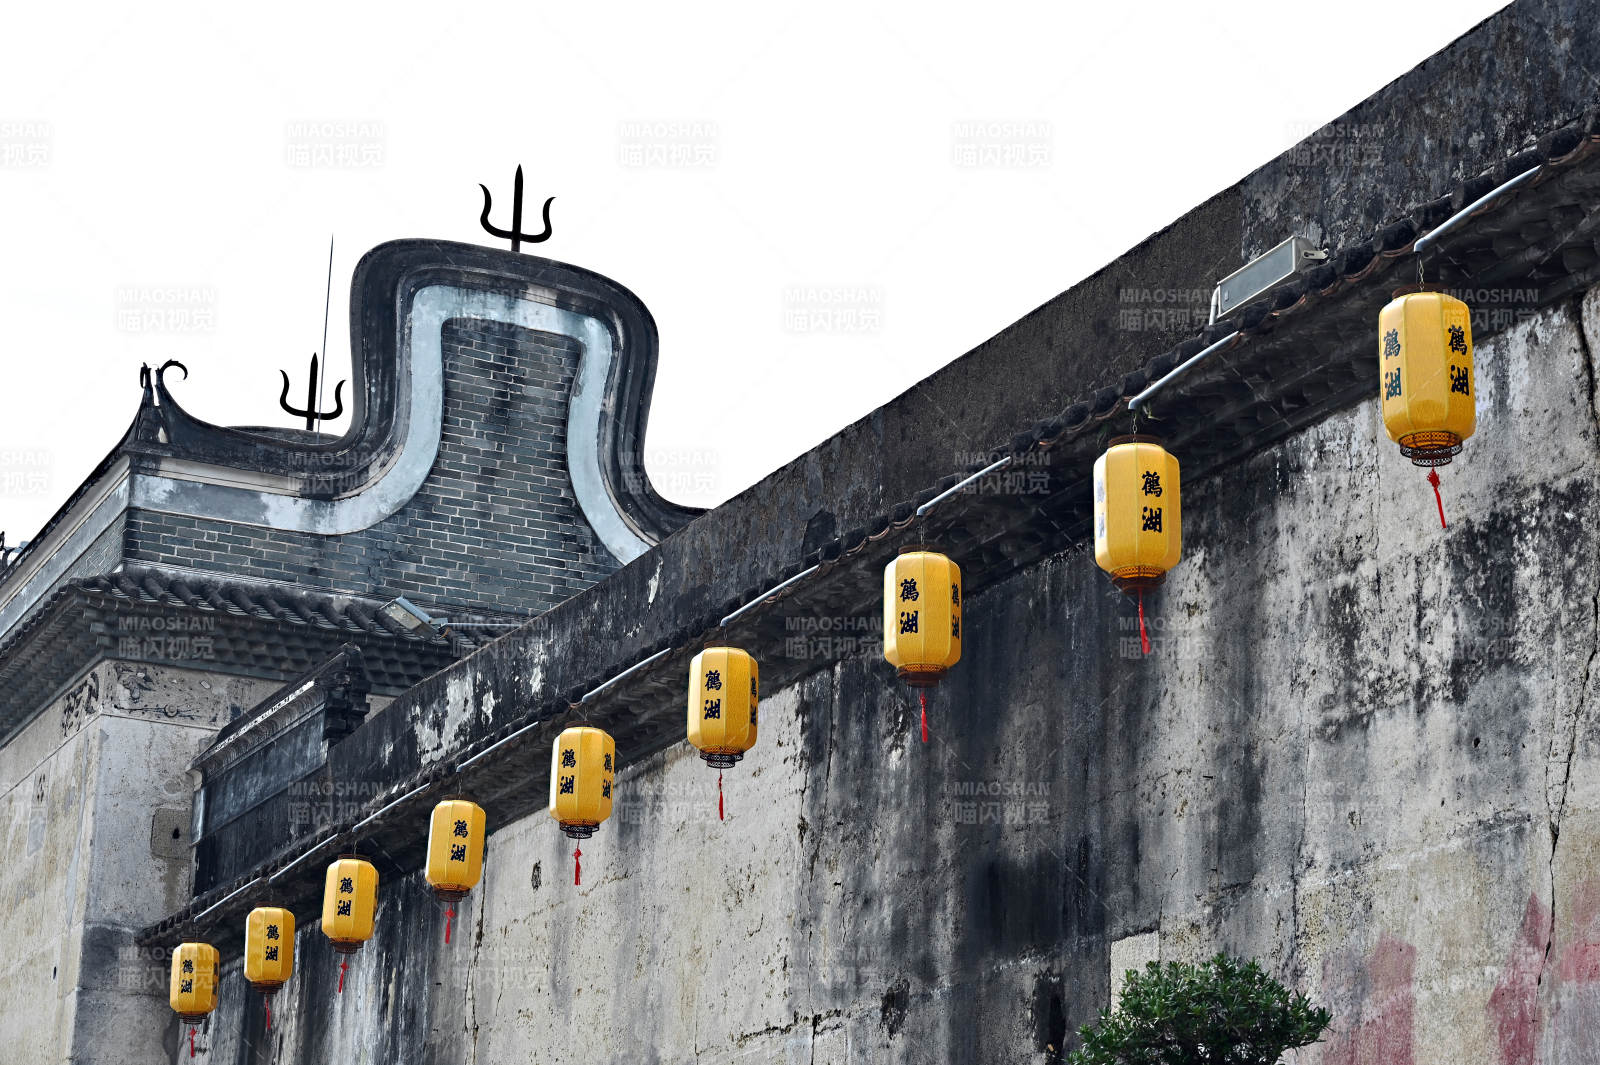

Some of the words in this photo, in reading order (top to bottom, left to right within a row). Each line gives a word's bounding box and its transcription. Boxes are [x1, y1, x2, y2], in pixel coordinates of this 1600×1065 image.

[1447, 324, 1470, 396] 鶴湖
[1141, 470, 1163, 533] 鶴湖
[899, 577, 919, 634] 鶴湖
[704, 669, 722, 720] 鶴湖
[560, 748, 576, 794] 鶴湖
[450, 819, 468, 862] 鶴湖
